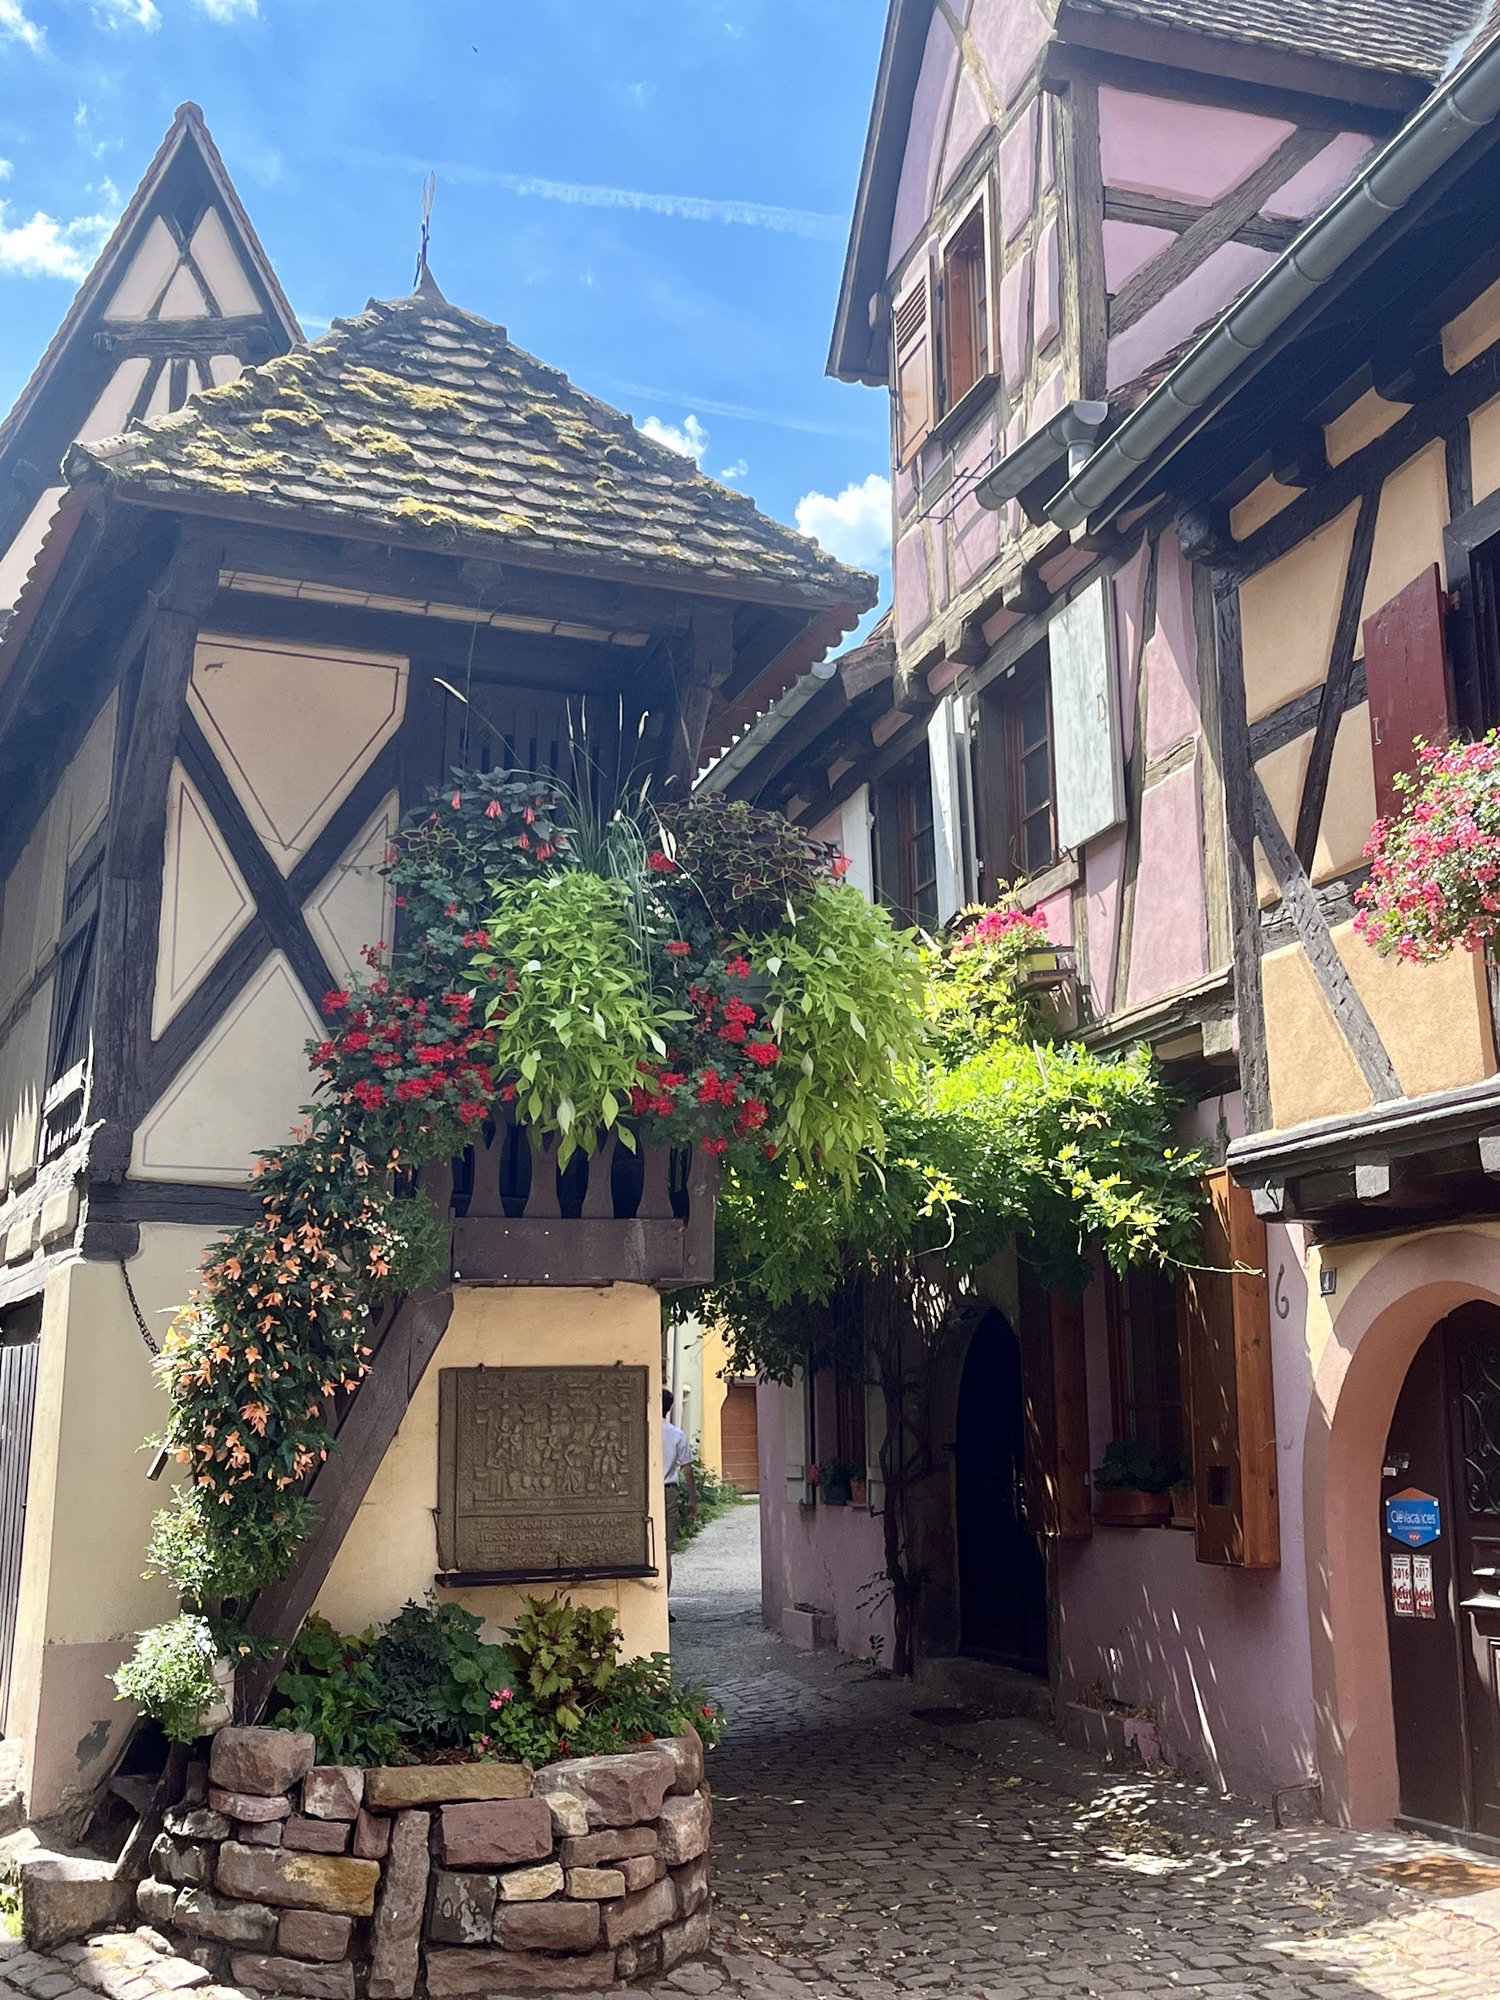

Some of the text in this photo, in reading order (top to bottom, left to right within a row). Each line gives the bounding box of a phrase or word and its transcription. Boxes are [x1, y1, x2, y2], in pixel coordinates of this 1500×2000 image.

[1275, 1263, 1289, 1319] 6
[1393, 1567, 1409, 1580] 2016
[1415, 1566, 1429, 1578] 2017
